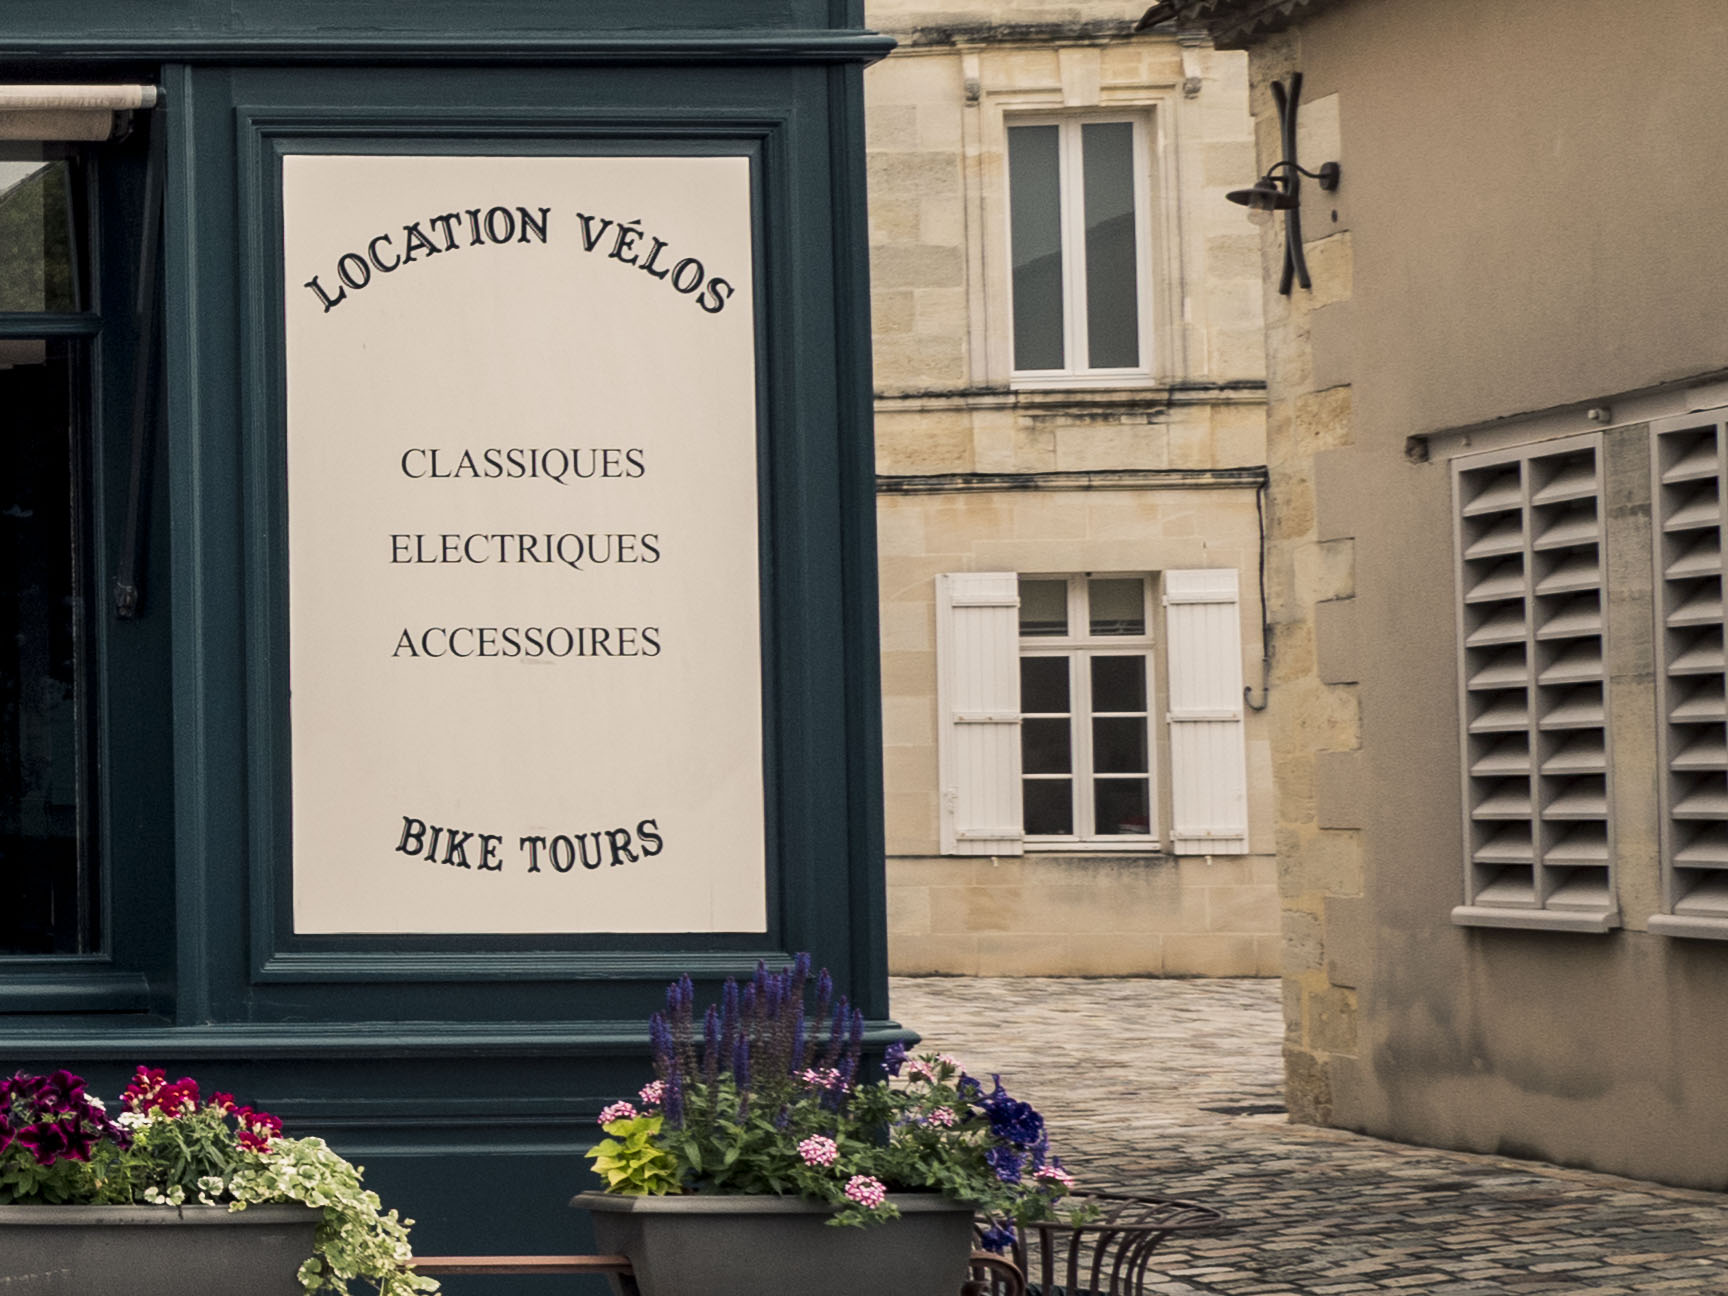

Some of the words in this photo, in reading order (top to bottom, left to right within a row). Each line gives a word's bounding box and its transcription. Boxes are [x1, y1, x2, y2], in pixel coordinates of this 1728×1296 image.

[303, 206, 552, 314] LOCATION
[575, 212, 735, 315] VÉLOS
[401, 448, 646, 485] CLASSIQUES
[390, 533, 662, 570] ELECTRIQUES
[392, 627, 662, 658] ACCESSOIRES
[395, 815, 504, 873] BIKE
[519, 817, 665, 873] TOURS
